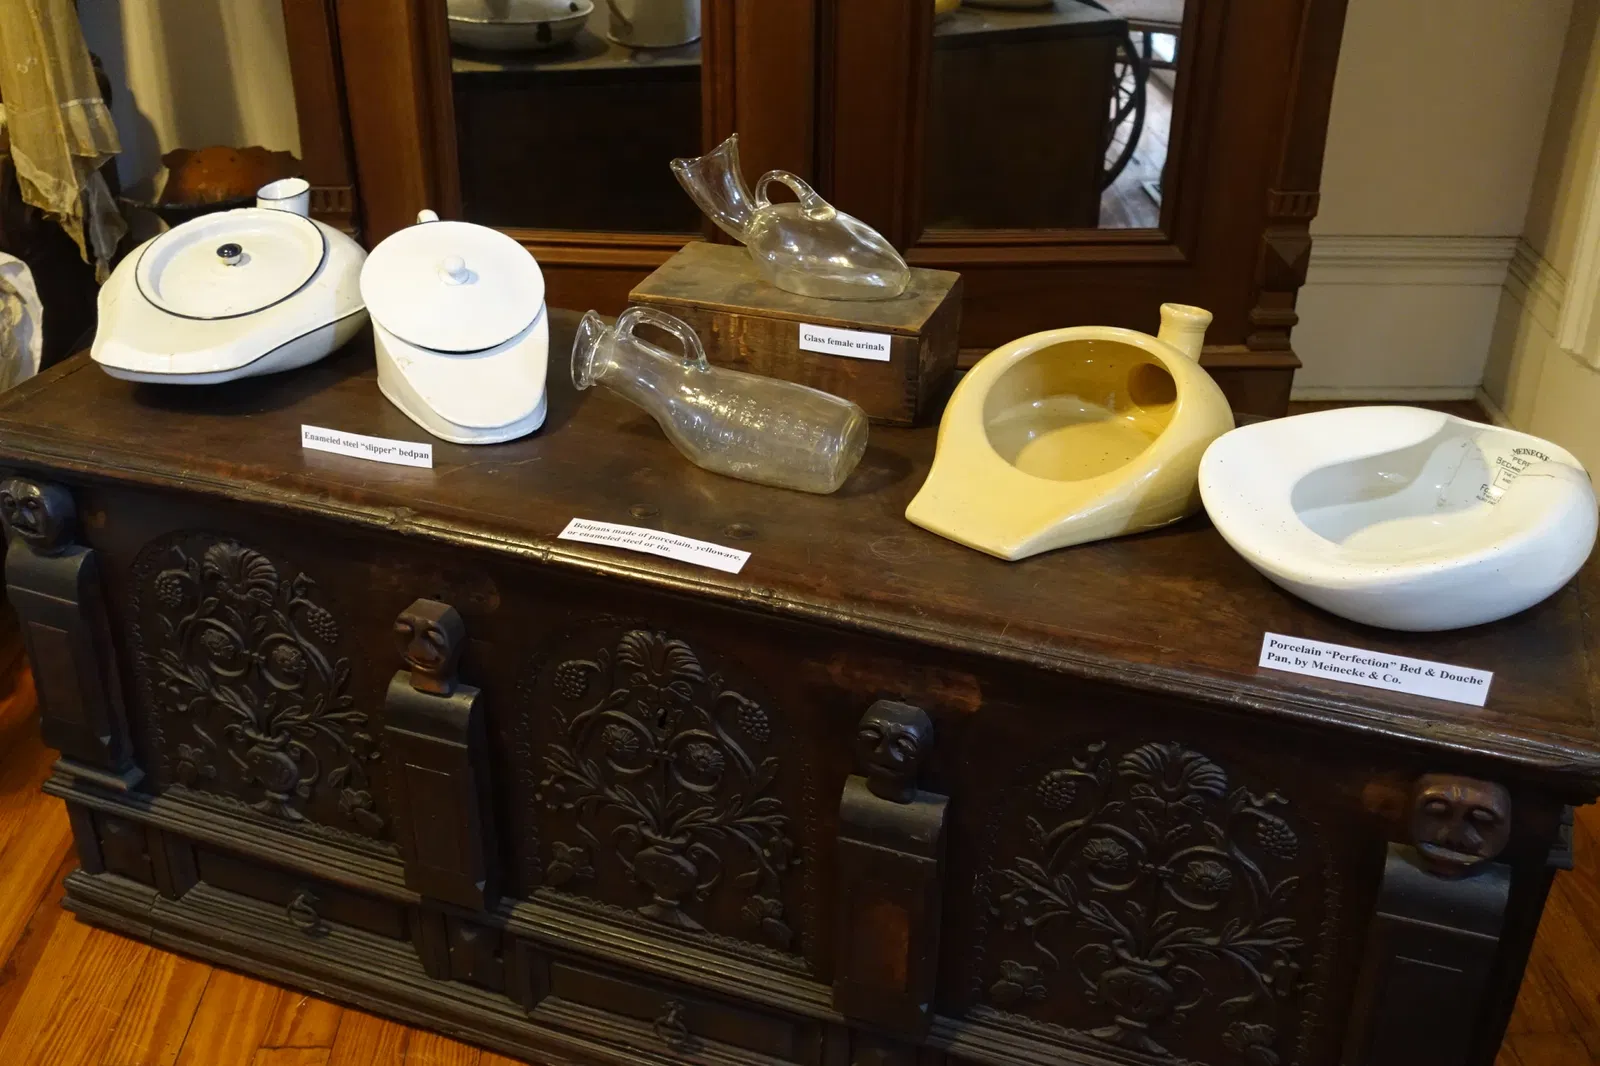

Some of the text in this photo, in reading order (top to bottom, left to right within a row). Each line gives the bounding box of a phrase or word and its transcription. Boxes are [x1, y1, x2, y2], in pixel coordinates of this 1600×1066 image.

[804, 333, 885, 352] Glass female urinals
[304, 431, 341, 445] Enameled
[342, 439, 359, 449] steel
[398, 448, 430, 459] bedpan
[573, 522, 611, 533] Bedpans
[612, 528, 637, 537] made
[649, 534, 694, 550] porcelain,
[695, 545, 742, 561] yelloware,
[579, 532, 621, 542] enameled
[656, 545, 671, 553] tin.
[1267, 651, 1402, 684] Pan, by Meinecke & Co.
[1270, 639, 1322, 657] Porcelain
[1399, 661, 1422, 675] Bed
[1424, 668, 1436, 677] &
[1439, 670, 1484, 686] Douche
